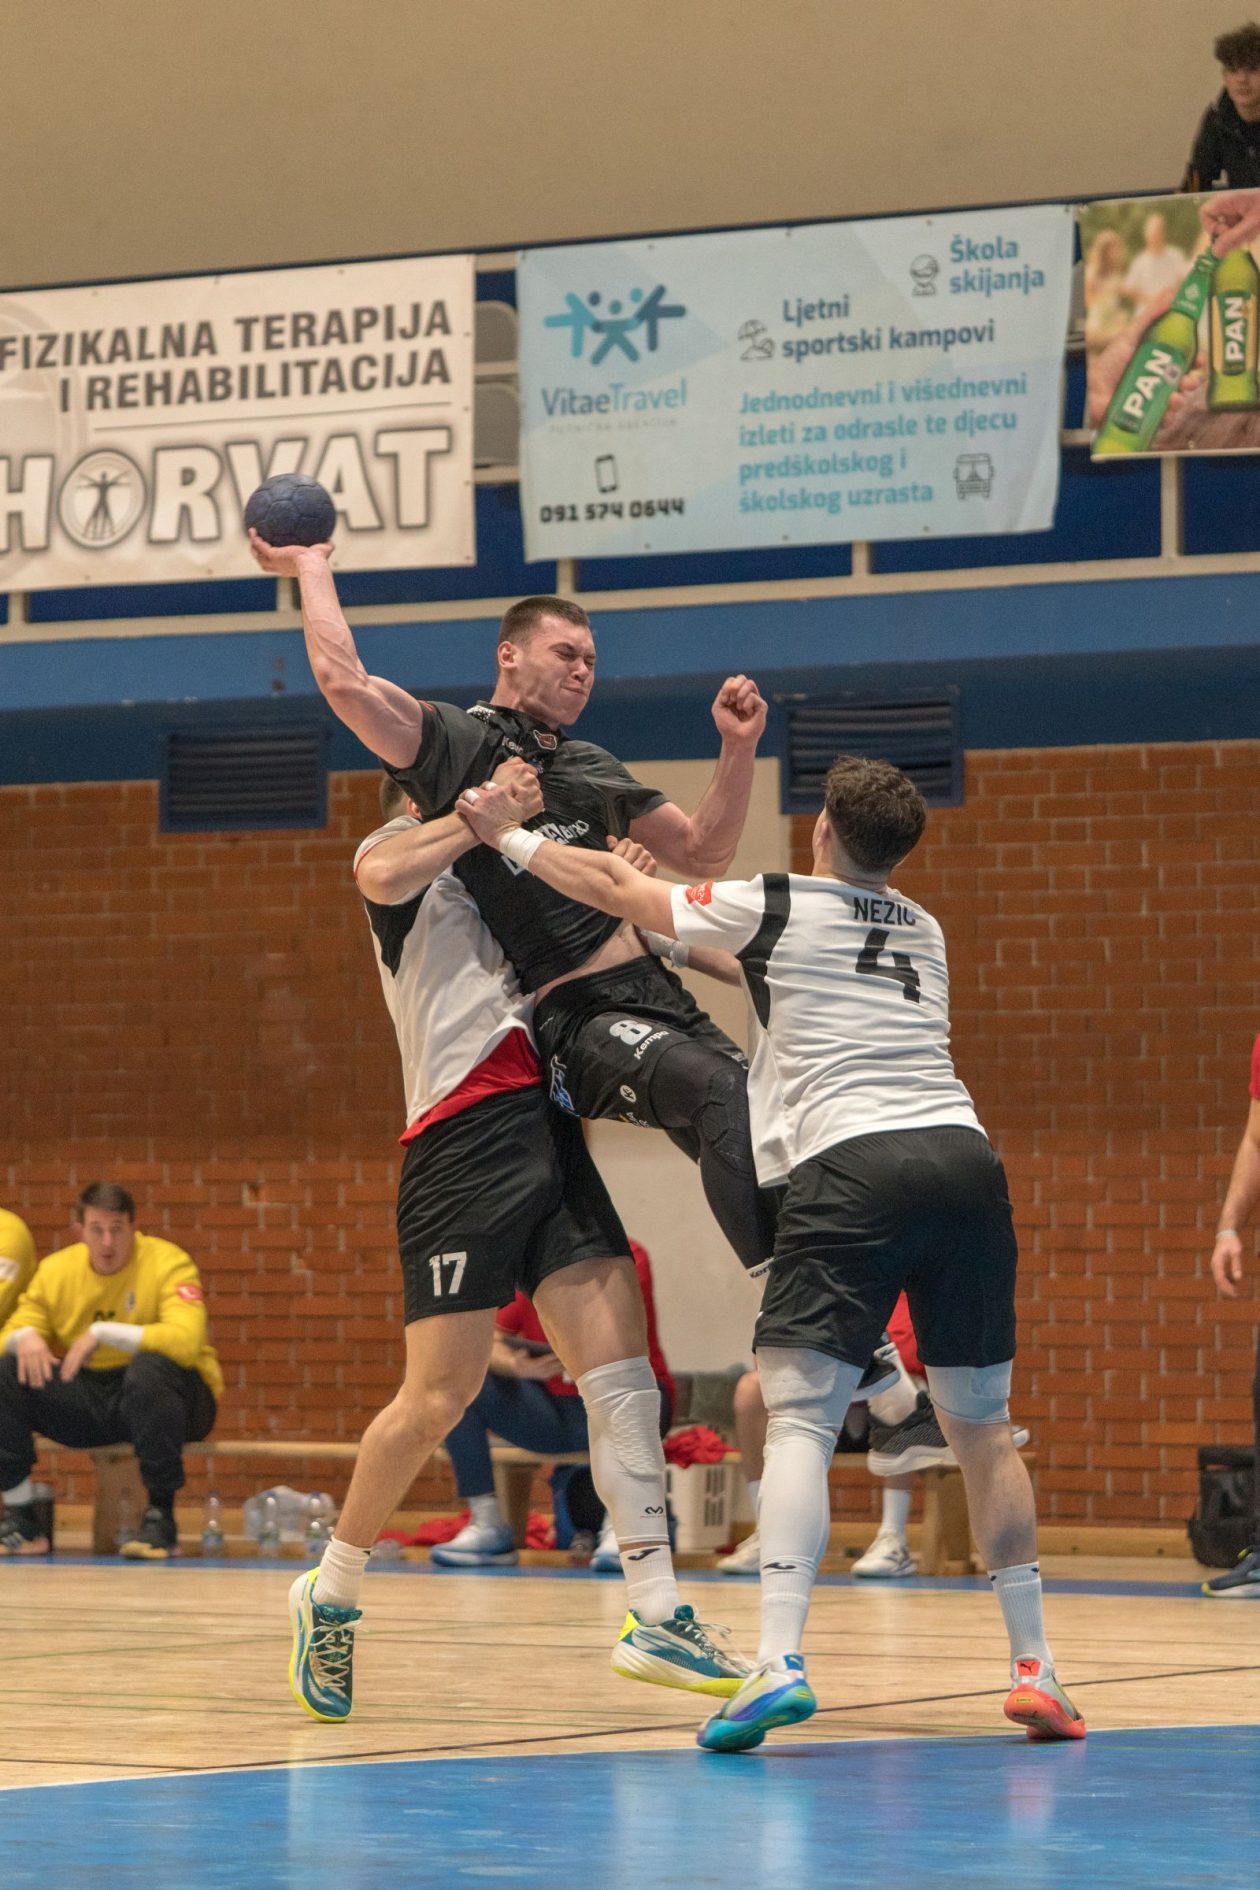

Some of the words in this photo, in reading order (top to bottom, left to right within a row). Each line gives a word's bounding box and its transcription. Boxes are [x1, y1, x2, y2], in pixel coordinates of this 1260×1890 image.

[950, 234, 1019, 264] Škola
[950, 265, 1046, 297] skijanja
[782, 294, 850, 328] Ljetni
[1225, 296, 1245, 362] PAN
[0, 321, 217, 372] FIZIKALNA
[234, 300, 452, 352] TERAPIJA
[781, 327, 881, 363] sportski
[889, 318, 994, 352] kampovi
[61, 378, 70, 413] I
[86, 348, 452, 411] REHABILITACIJA
[541, 379, 688, 417] VitaeTravel
[739, 382, 882, 415] Jednodnevni
[887, 380, 896, 403] i
[901, 372, 1028, 402] višednevni
[1123, 348, 1172, 418] PAN
[738, 423, 795, 448] izleti
[802, 423, 828, 445] za
[834, 414, 917, 441] odrasle
[925, 414, 948, 435] te
[954, 409, 1018, 438] djecu
[739, 451, 894, 486] predškolskog
[900, 448, 908, 470] i
[540, 504, 578, 523] 091
[585, 501, 623, 521] 574
[629, 498, 685, 518] 0644
[739, 486, 842, 515] školskog
[848, 482, 935, 507] uzrasta
[855, 927, 921, 1005] 4
[609, 1019, 653, 1046] 8
[633, 1030, 670, 1060] Kempa
[429, 1251, 467, 1297] 17
